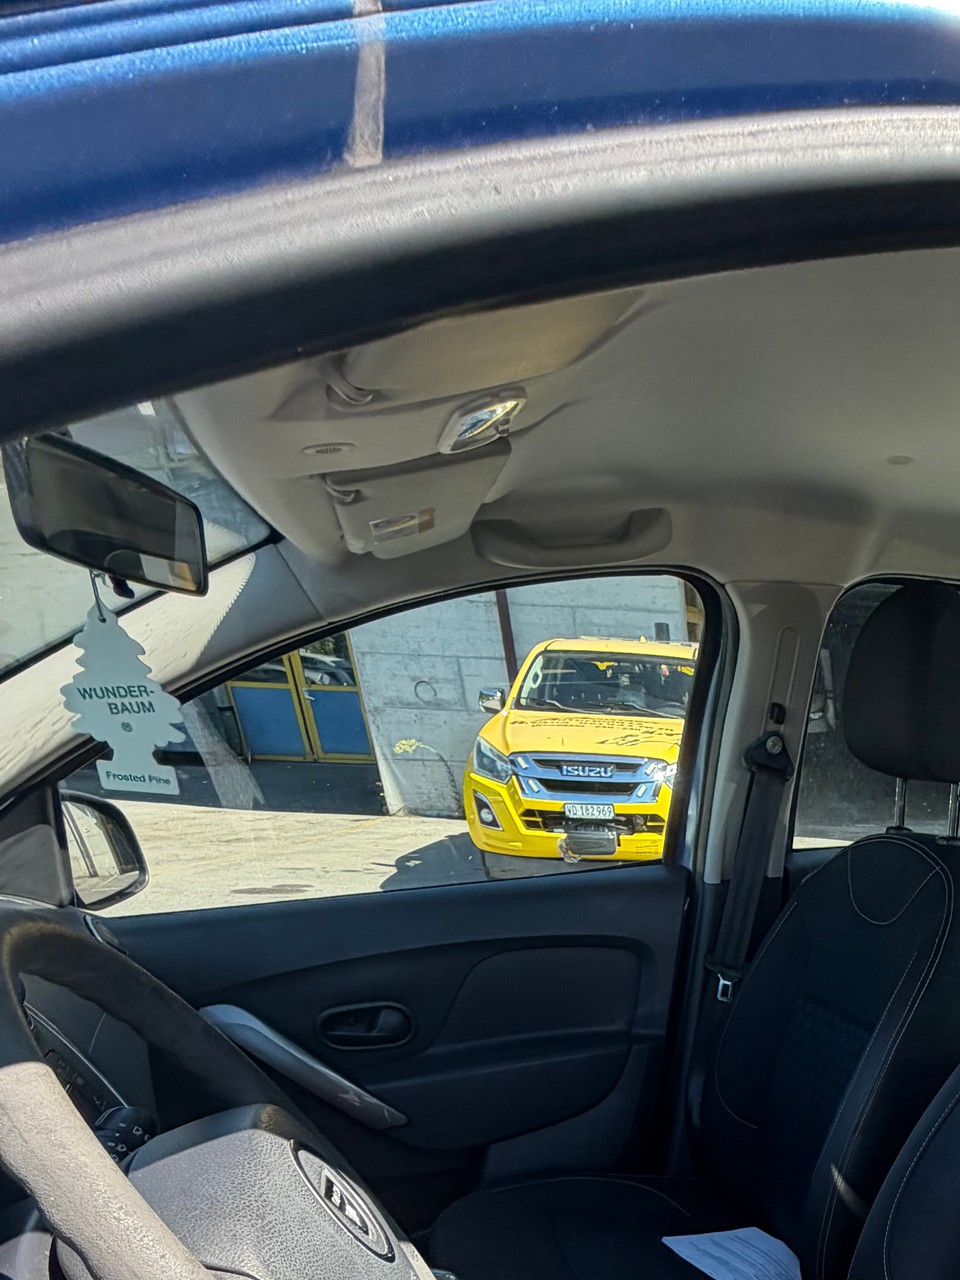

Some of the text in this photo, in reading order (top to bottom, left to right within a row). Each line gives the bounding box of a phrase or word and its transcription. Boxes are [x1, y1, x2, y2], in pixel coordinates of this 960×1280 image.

[77, 685, 155, 700] WUNDER-
[107, 701, 156, 715] BAUM
[106, 770, 171, 785] Frosted Pine
[562, 765, 612, 777] ISUZU
